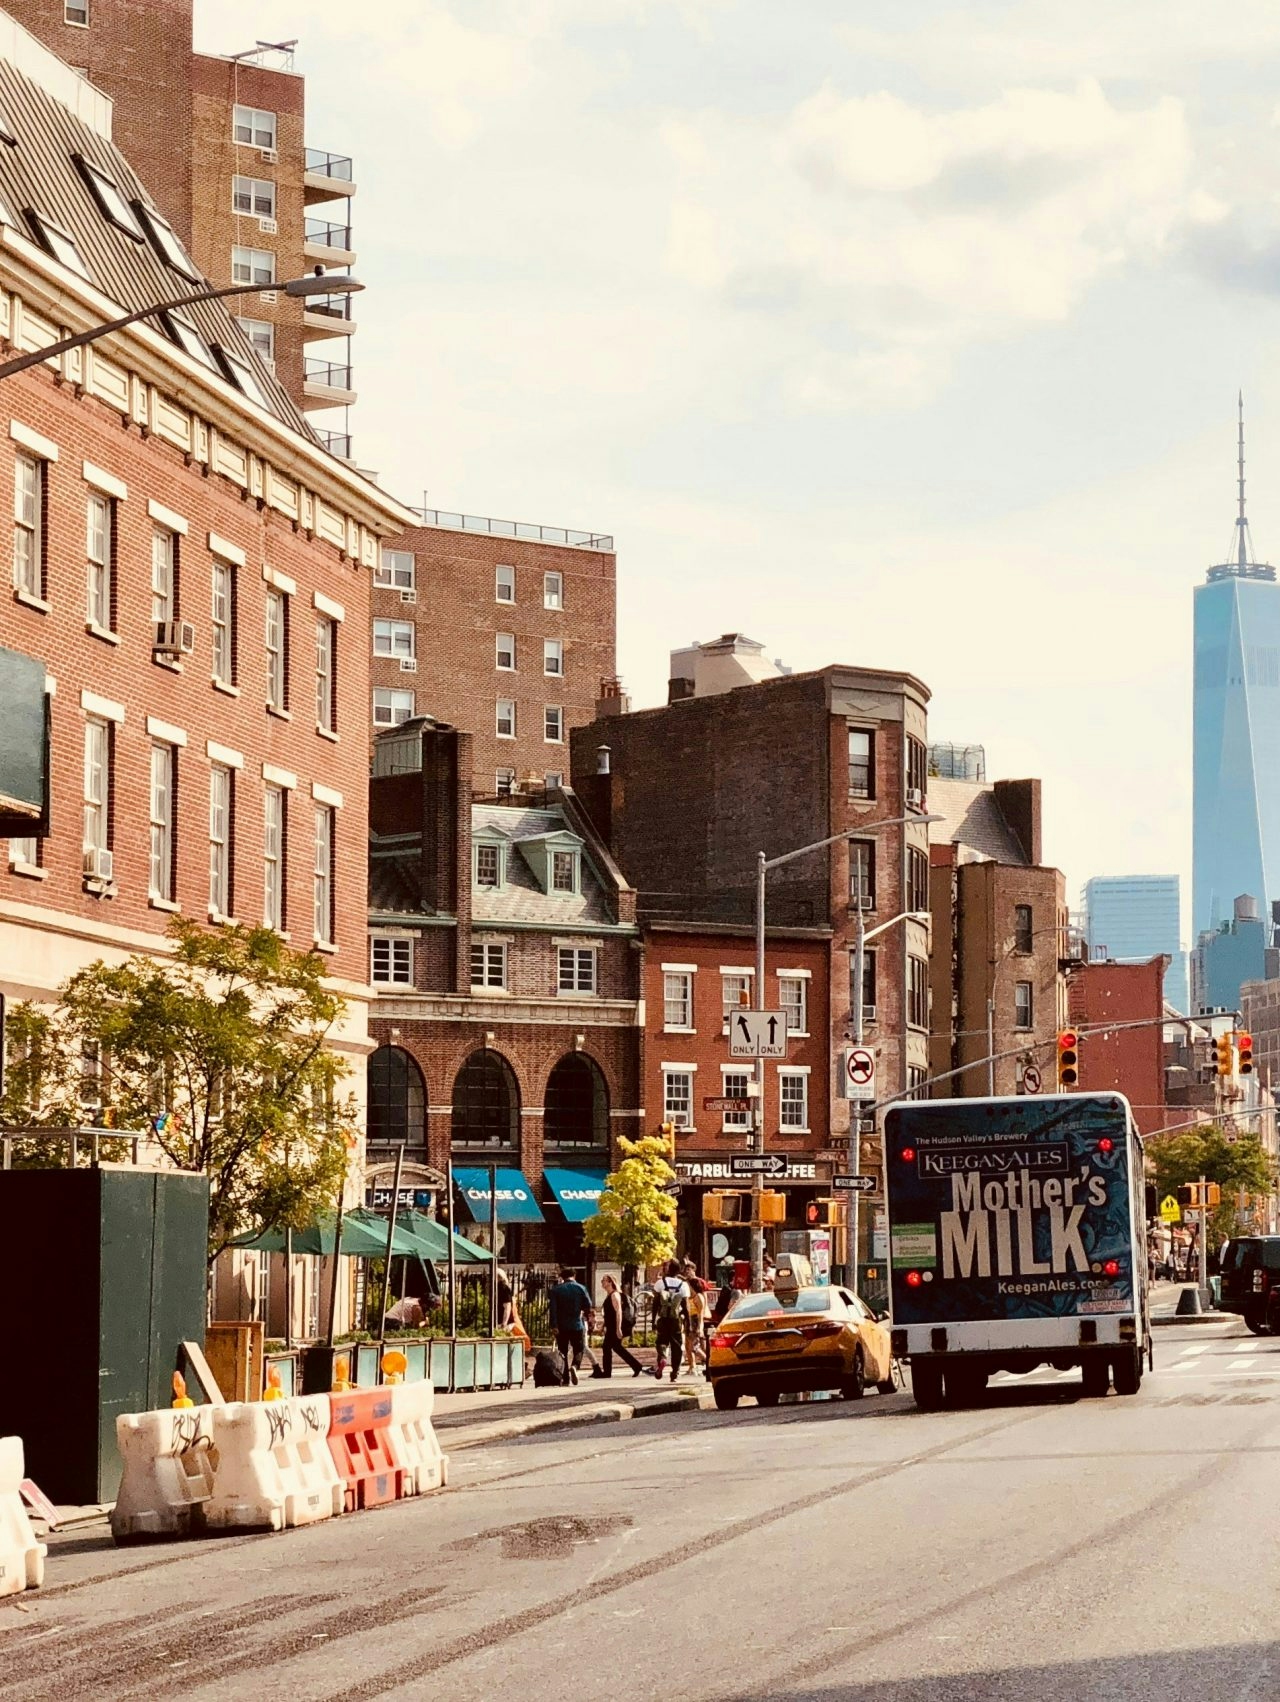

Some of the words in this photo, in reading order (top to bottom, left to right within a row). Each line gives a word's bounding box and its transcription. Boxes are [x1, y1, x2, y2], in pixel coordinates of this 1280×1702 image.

[733, 1046, 755, 1054] ONLY
[760, 1046, 783, 1054] ONLY
[915, 1137, 930, 1145] The
[931, 1135, 961, 1144] Hudson
[963, 1133, 993, 1143] Valley's
[994, 1133, 1028, 1142] Brewery
[738, 1160, 755, 1168] ONE
[762, 1160, 779, 1168] WAY
[925, 1152, 1006, 1173] KEEGAN
[675, 1163, 753, 1178] TARBU
[765, 1164, 816, 1178] FFEE
[467, 1189, 514, 1200] CHASE
[951, 1165, 1107, 1212] Mother's
[940, 1204, 1090, 1279] MILK
